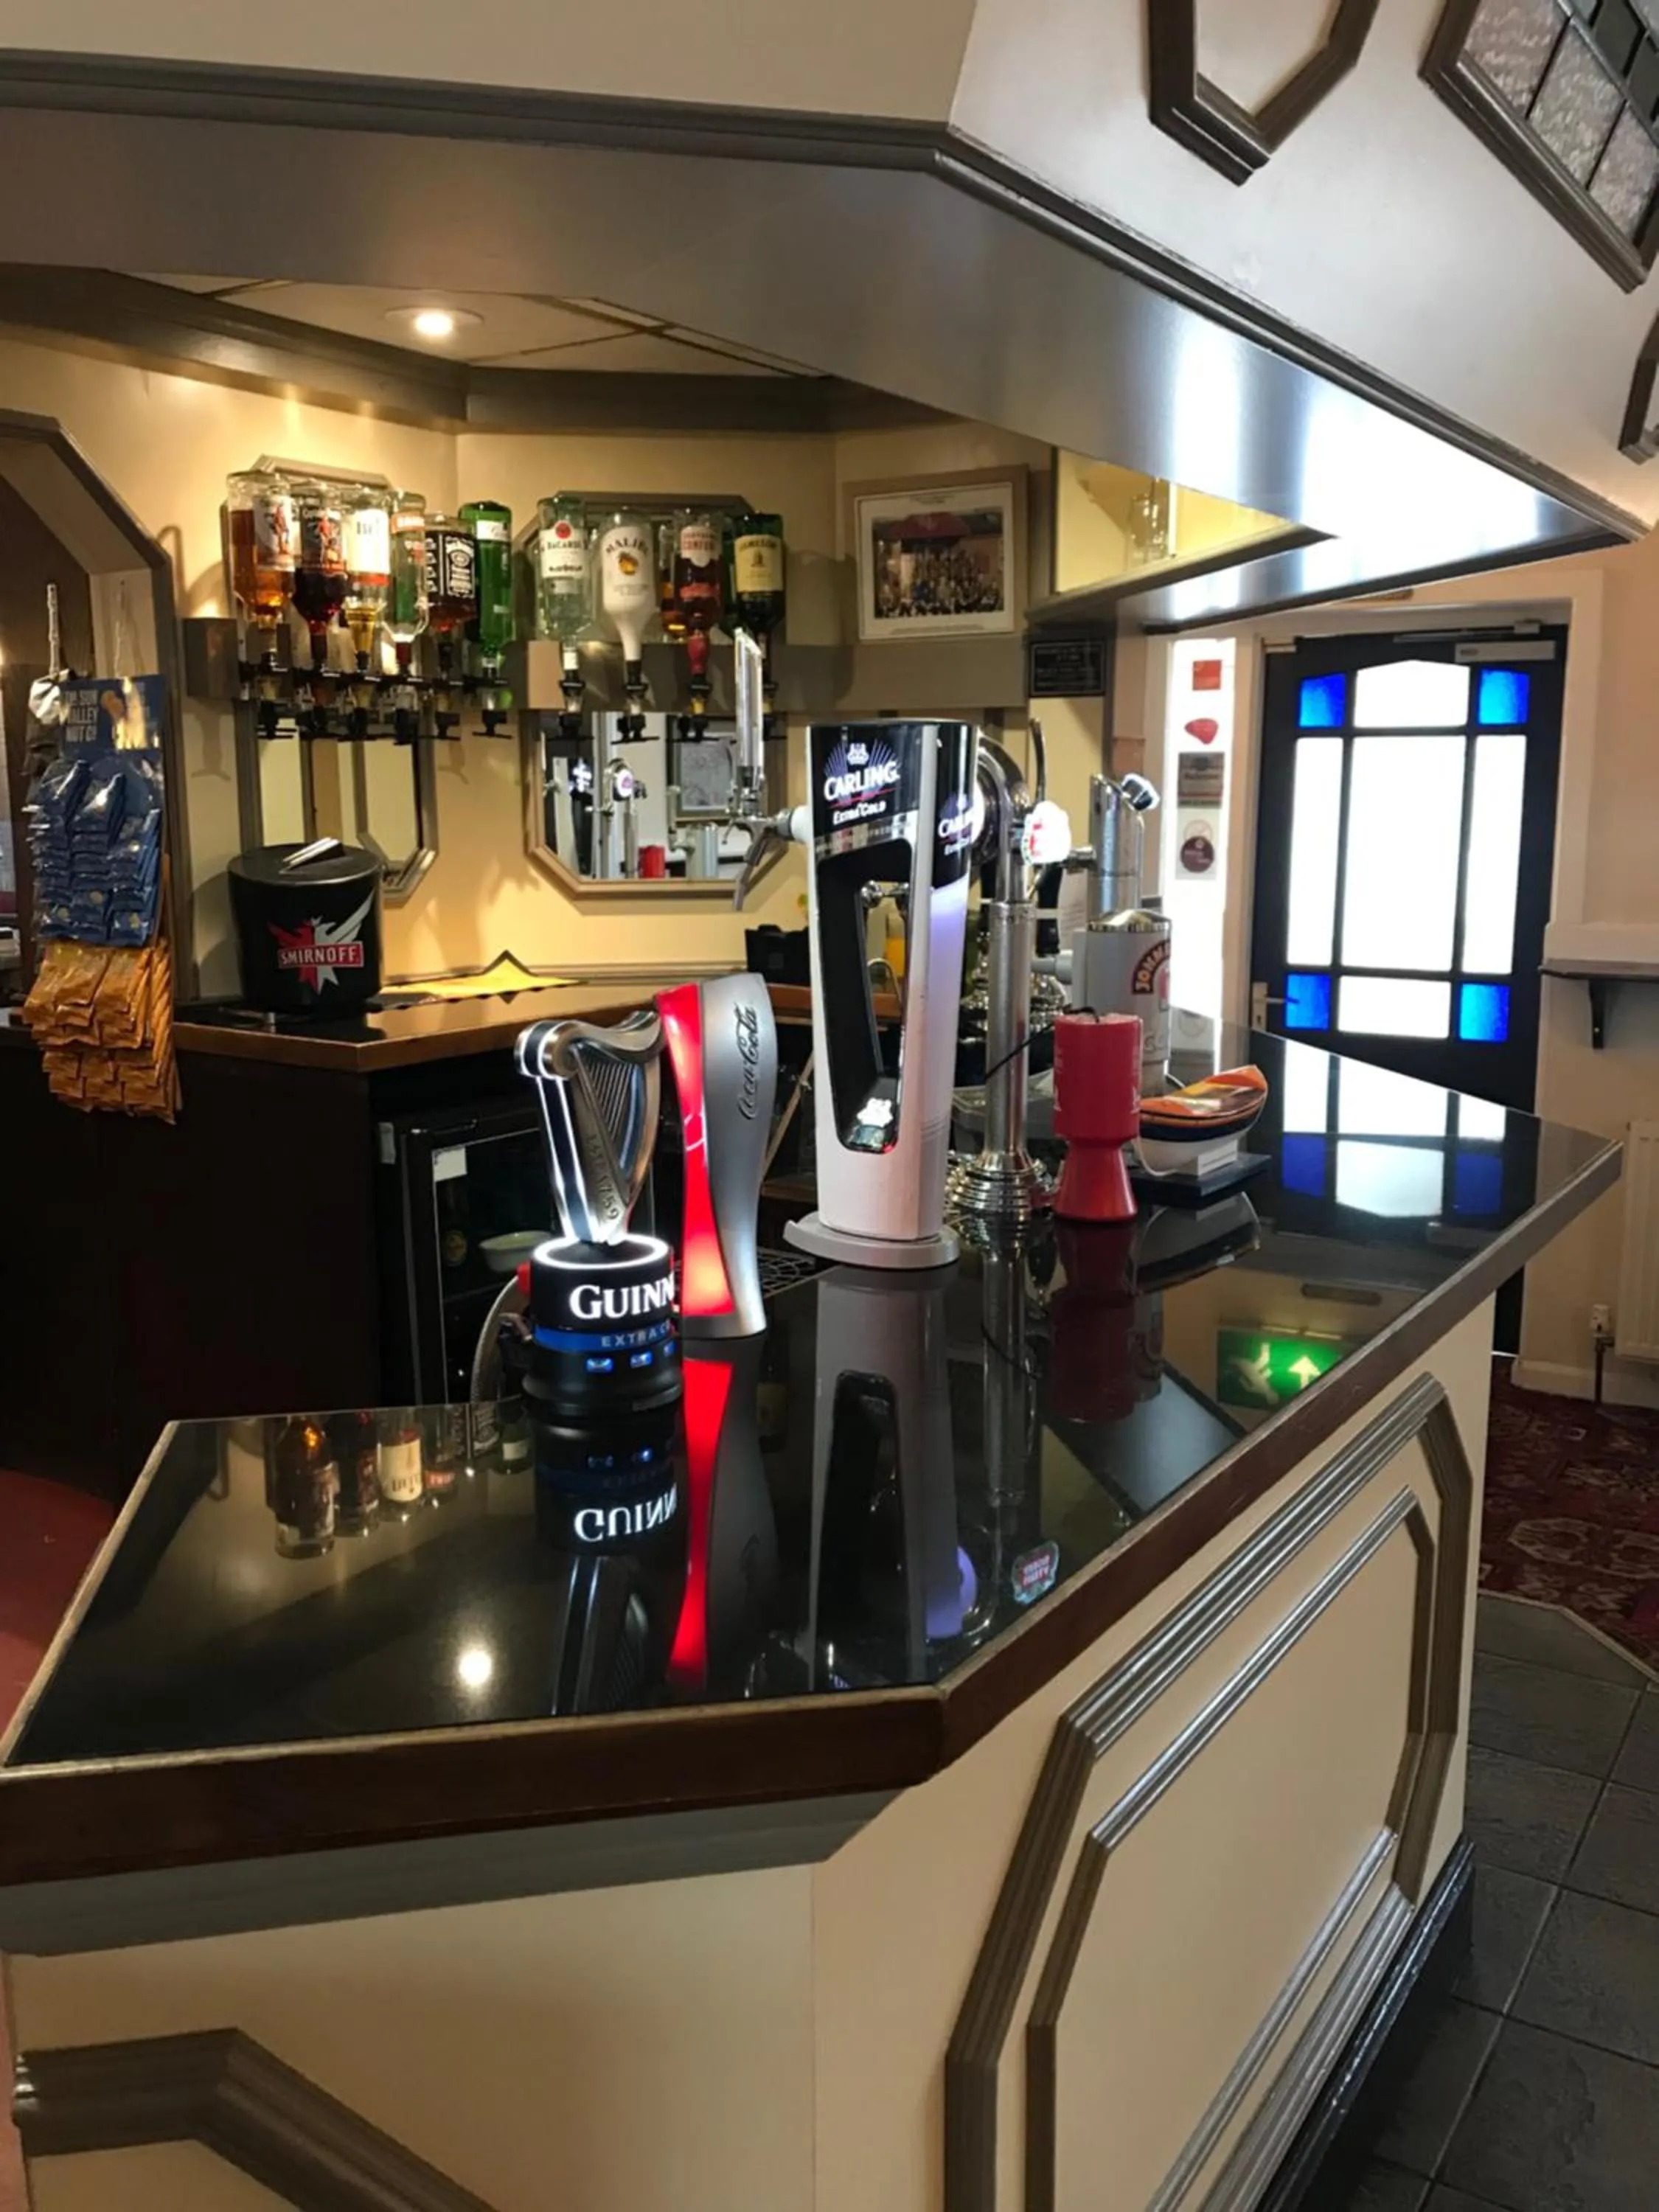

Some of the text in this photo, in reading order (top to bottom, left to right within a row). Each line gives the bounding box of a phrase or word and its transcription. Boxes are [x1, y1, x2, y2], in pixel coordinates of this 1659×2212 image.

[605, 537, 649, 555] MALIBU
[824, 760, 900, 801] CARLING
[282, 946, 357, 964] SMIRNOFF
[734, 1002, 759, 1120] Coca-Cola
[601, 1328, 657, 1348] EXTRA
